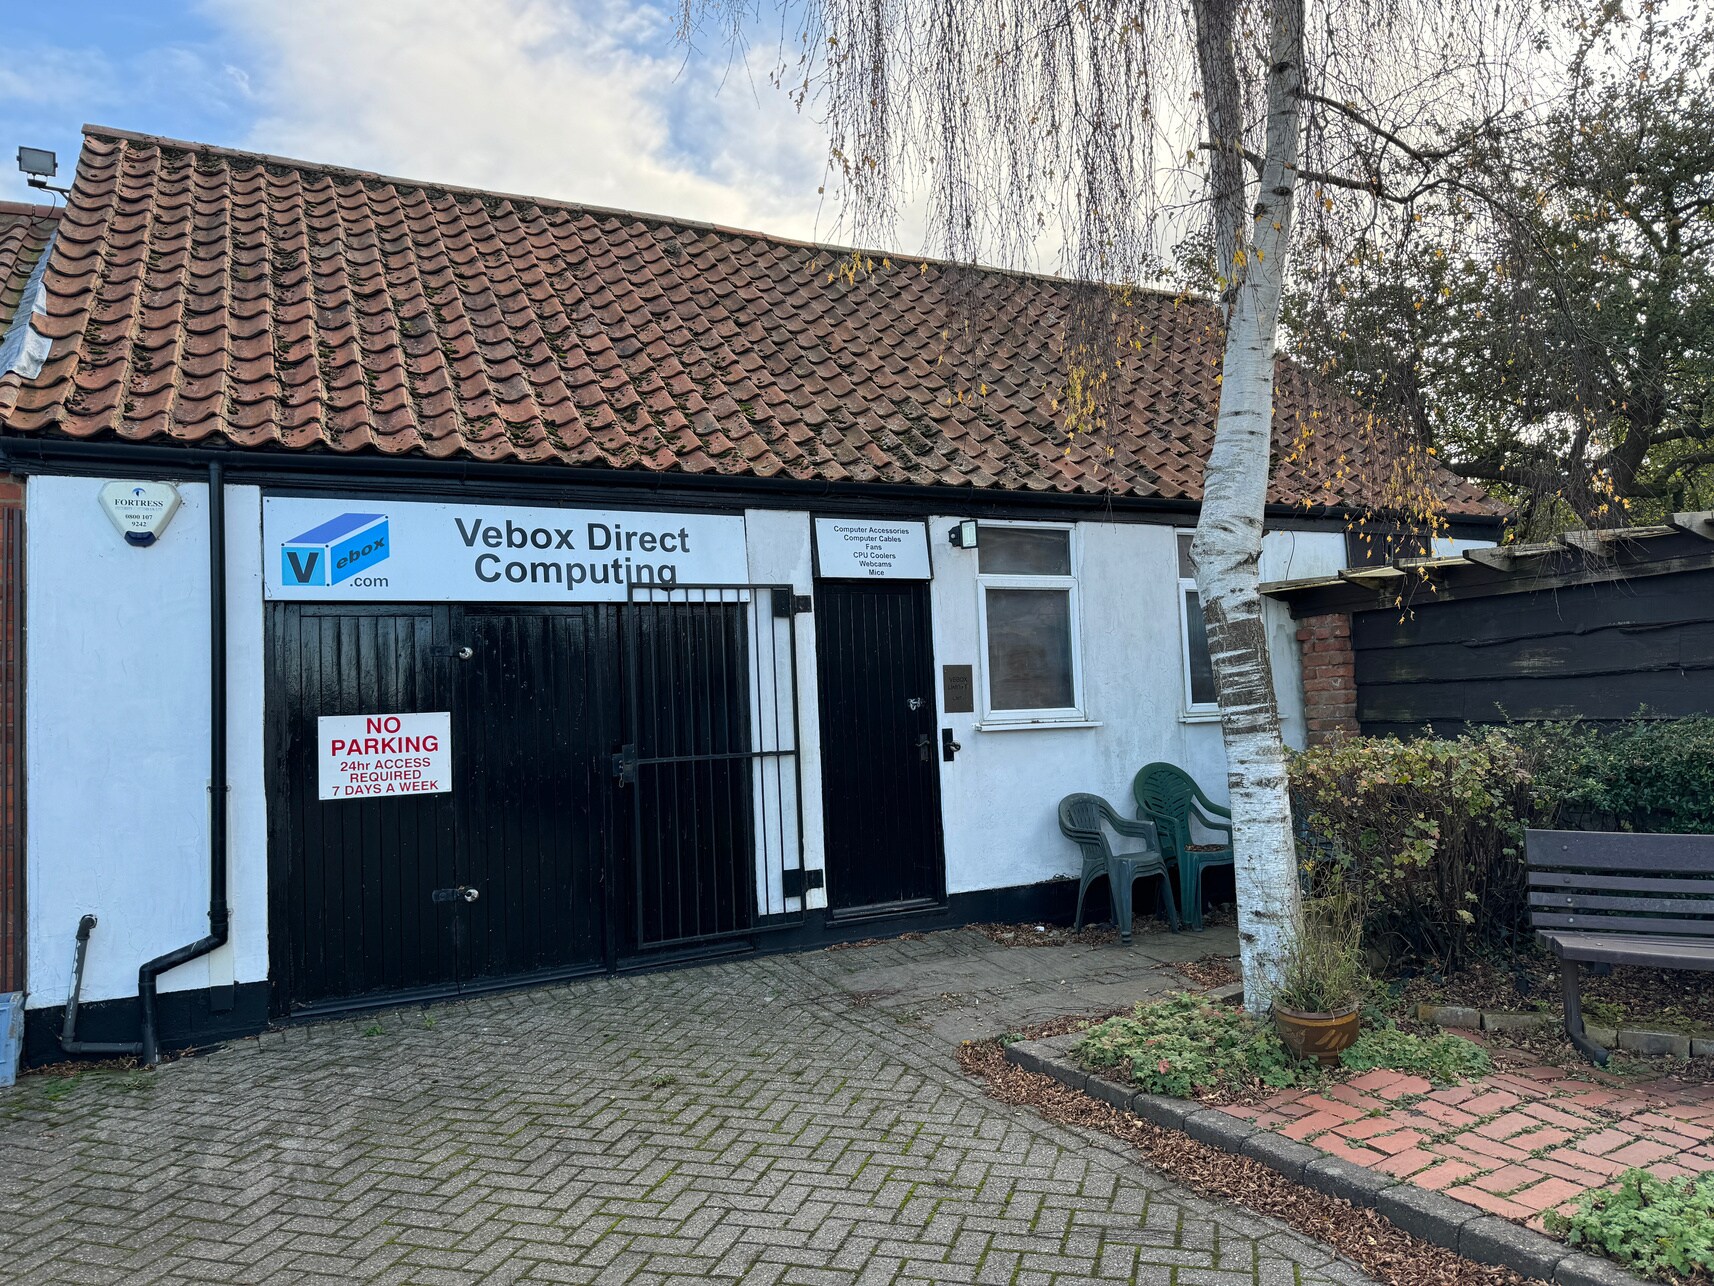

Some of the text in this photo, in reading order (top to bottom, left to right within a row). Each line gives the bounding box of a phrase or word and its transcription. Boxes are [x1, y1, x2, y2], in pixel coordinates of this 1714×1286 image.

[114, 498, 164, 507] FORTRESS
[454, 517, 691, 553] Vebox Direct
[833, 525, 910, 535] Computer Accessories
[843, 534, 902, 543] Computer Cables
[865, 543, 883, 551] Fans
[853, 551, 897, 560] CPU Coolers
[859, 560, 892, 568] Webcams
[474, 553, 677, 592] Computing
[349, 577, 389, 588] .com
[366, 716, 401, 735] NO
[331, 735, 439, 757] PARKING
[340, 757, 431, 772] 24hr ACCESS
[350, 769, 422, 783] REQUIRED
[332, 780, 439, 796] 7 DAYS A WEEK
